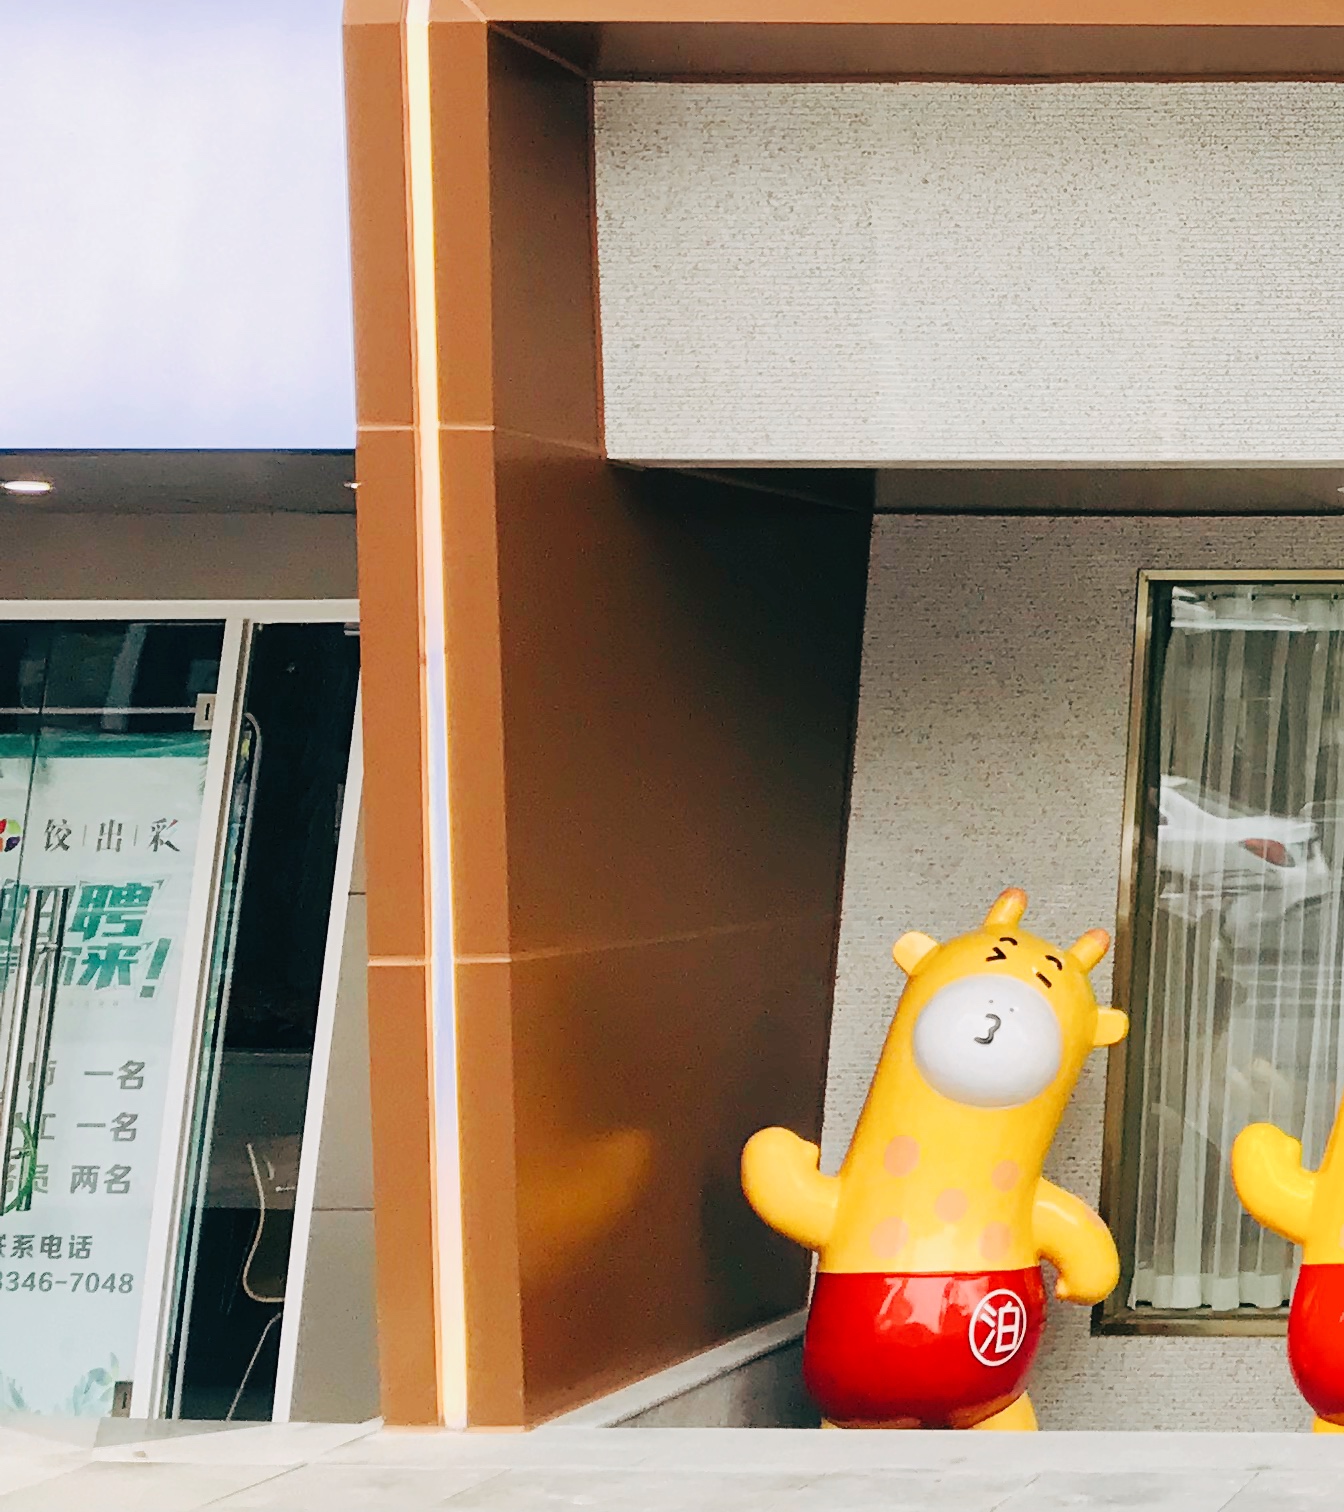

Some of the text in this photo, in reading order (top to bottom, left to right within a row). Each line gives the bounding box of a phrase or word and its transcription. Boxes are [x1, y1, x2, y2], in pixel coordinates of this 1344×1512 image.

[84, 1060, 146, 1090] 一名
[76, 1112, 139, 1142] 一名
[70, 1163, 132, 1194] 两名
[0, 1234, 93, 1259] 系电话
[0, 1271, 134, 1294] 346-7048
[975, 1295, 1023, 1358] 泊
